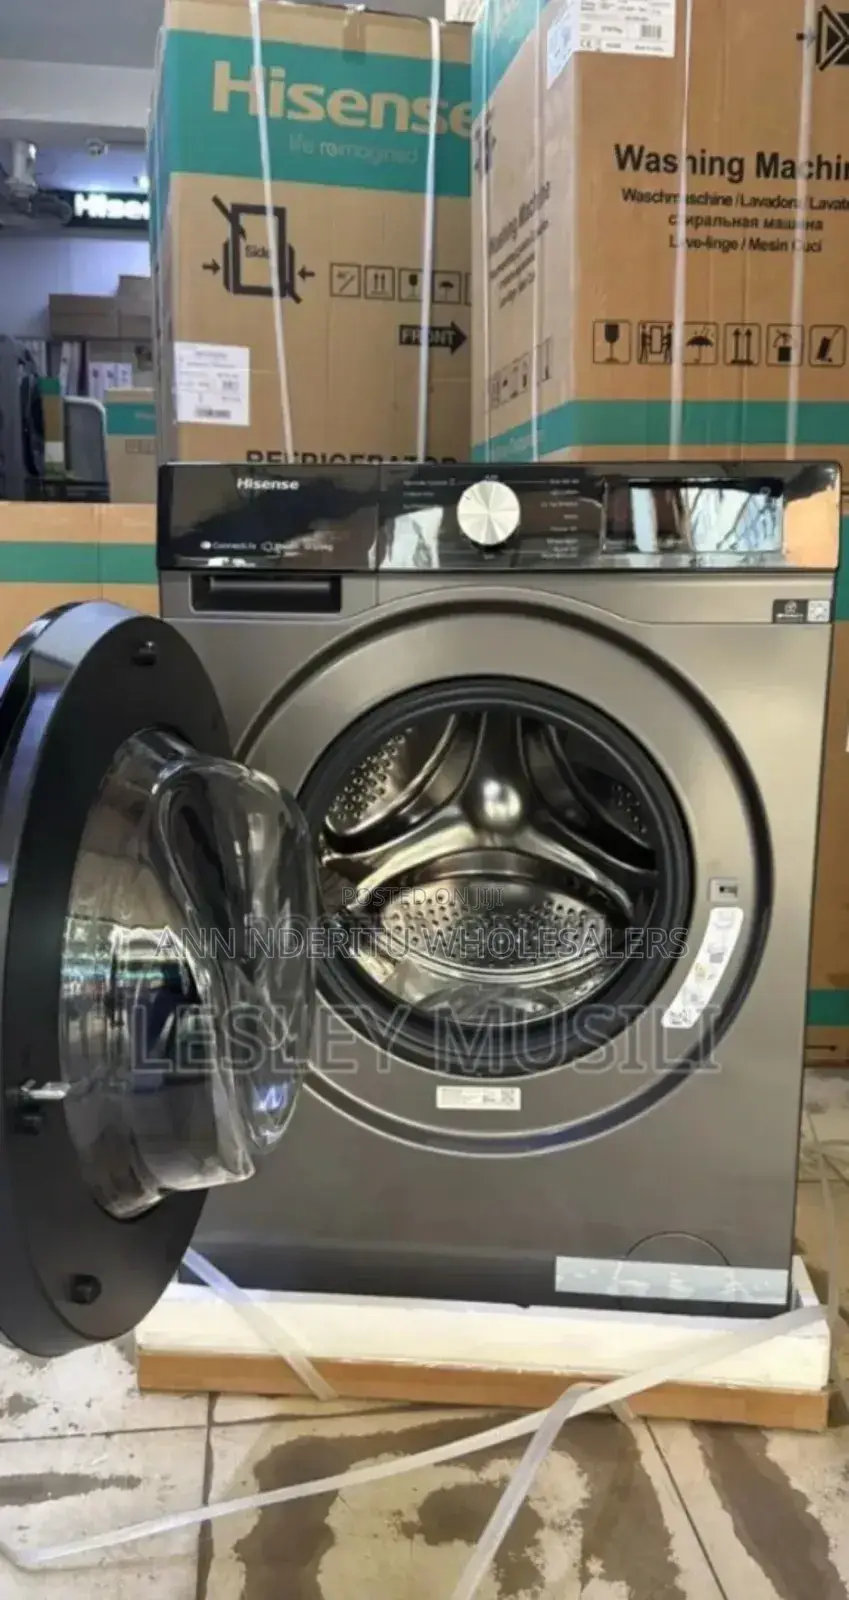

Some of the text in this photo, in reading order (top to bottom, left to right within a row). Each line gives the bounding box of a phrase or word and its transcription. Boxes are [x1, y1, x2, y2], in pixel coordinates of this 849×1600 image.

[212, 60, 471, 139] Hisense
[668, 214, 824, 231] сиральная машна
[669, 234, 738, 254] Lve-linge
[402, 328, 457, 345] FRNT
[236, 477, 300, 491] Hisense
